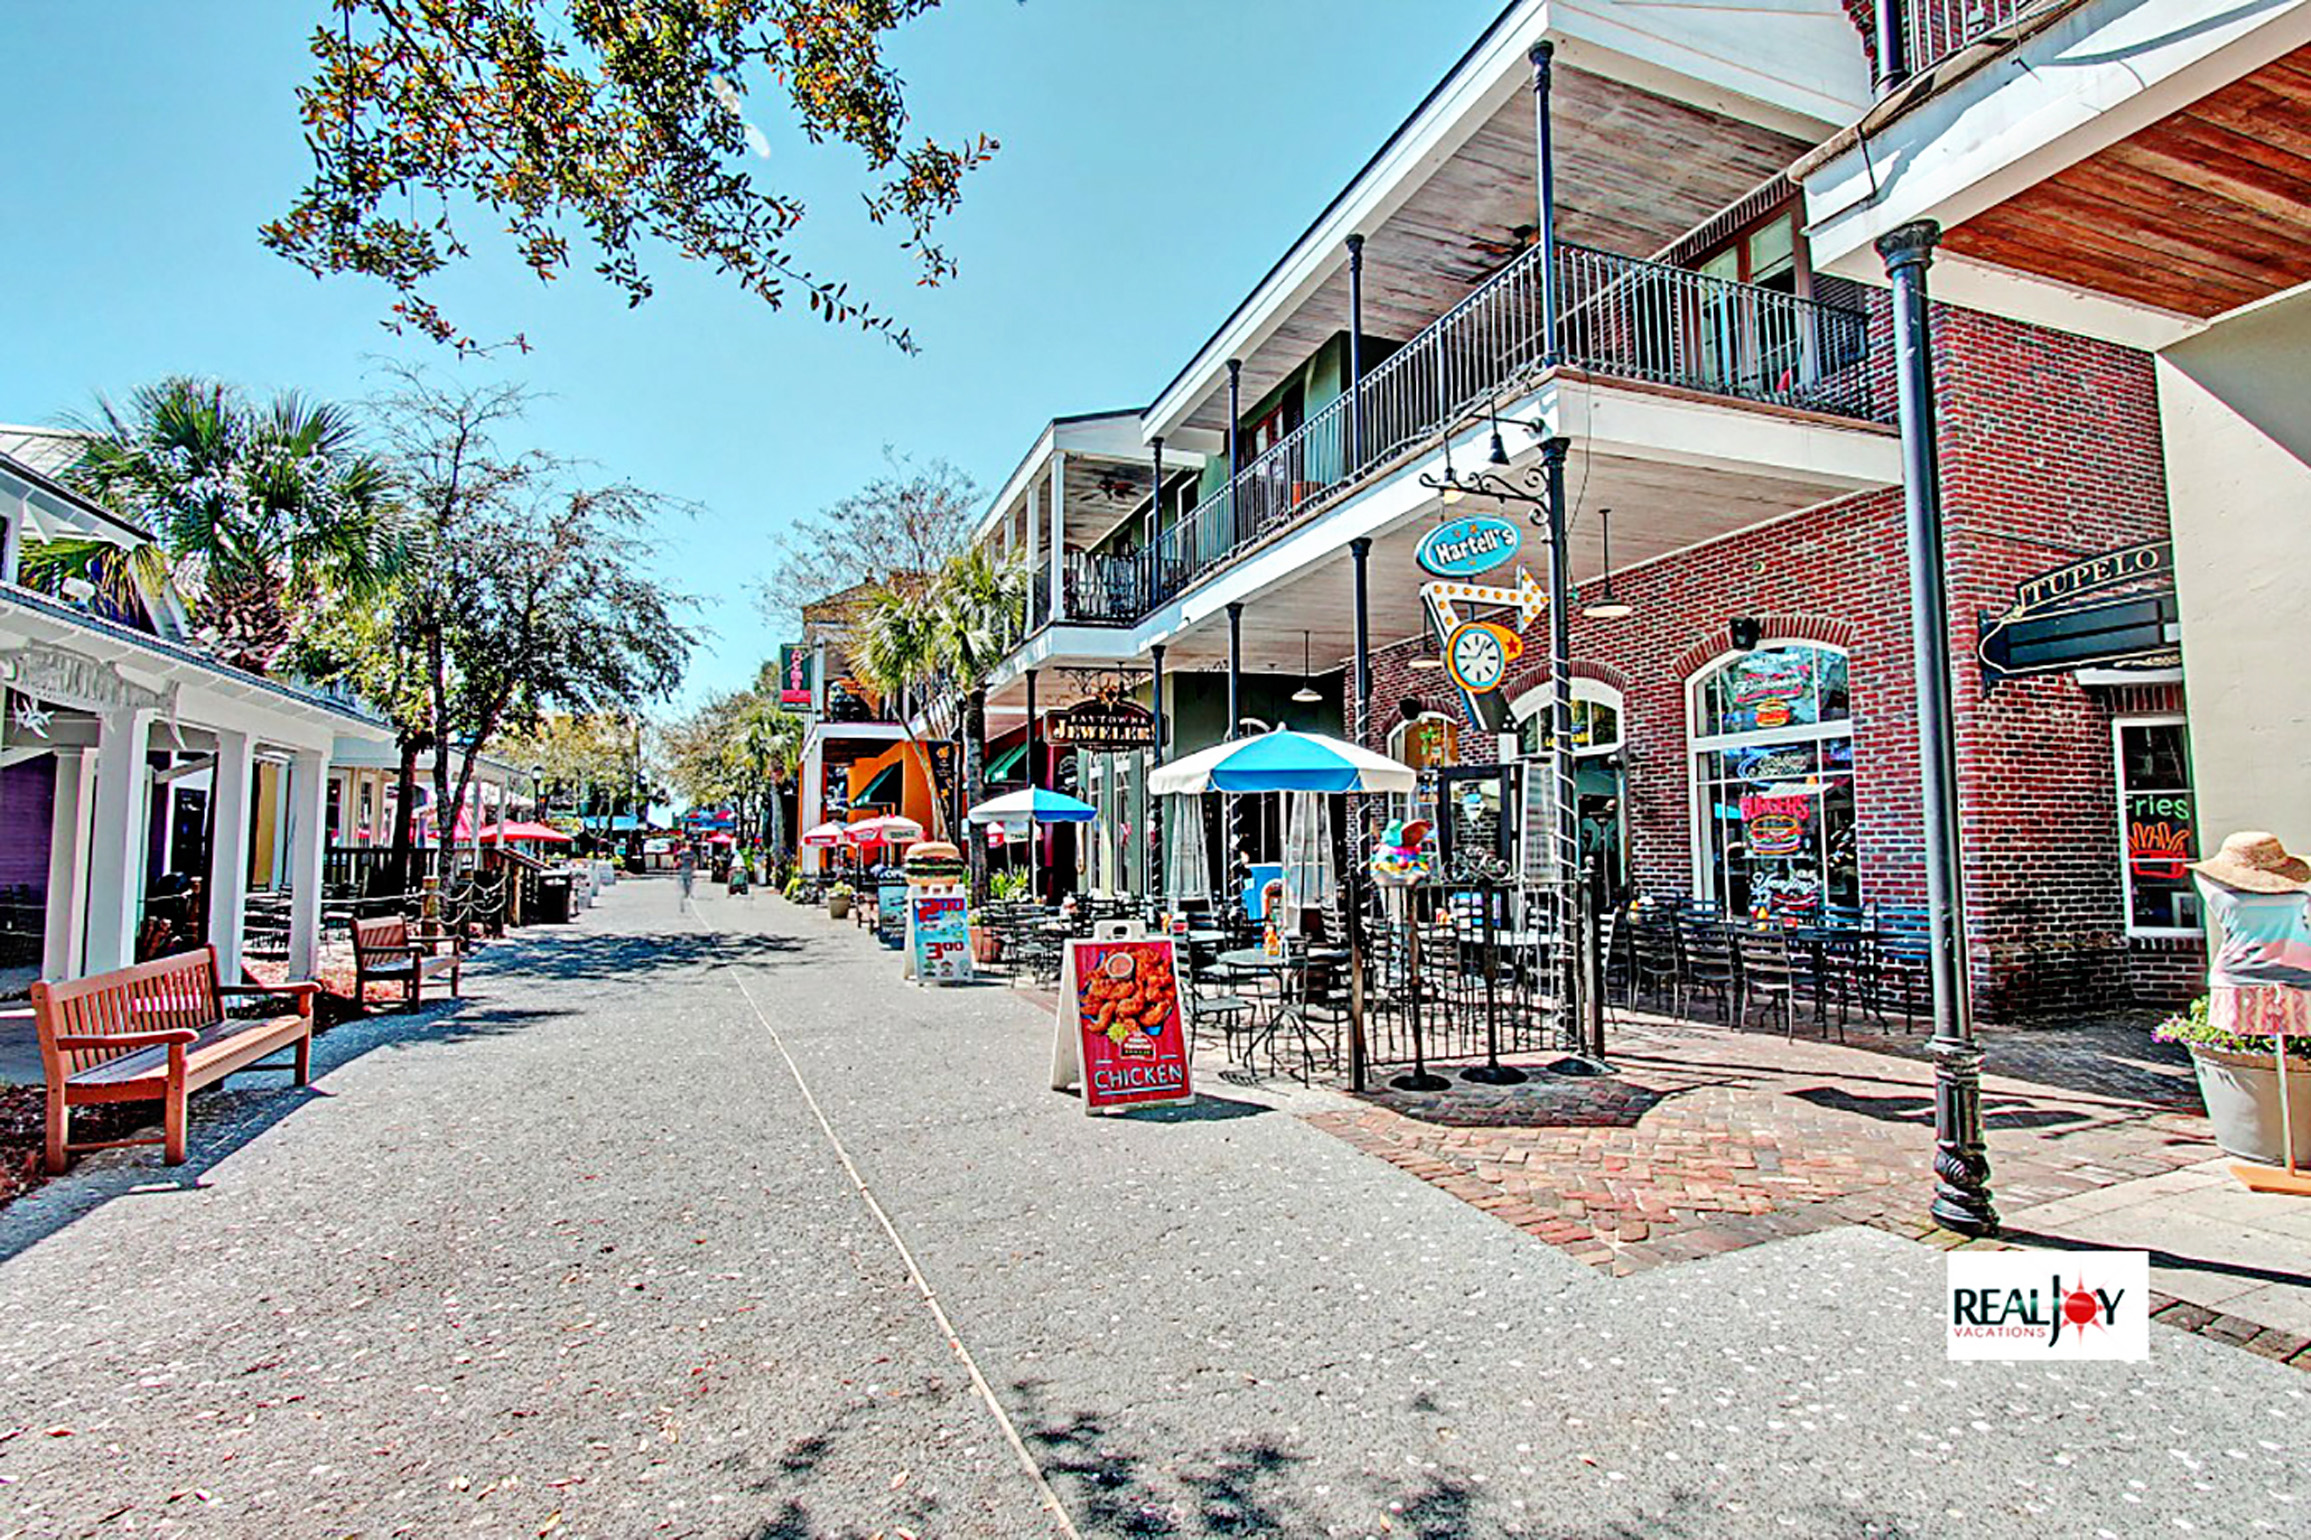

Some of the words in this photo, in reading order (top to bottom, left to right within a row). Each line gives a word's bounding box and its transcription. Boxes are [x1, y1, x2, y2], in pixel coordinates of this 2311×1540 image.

[1434, 528, 1514, 565] Hartell's
[2027, 549, 2159, 602] TUPELO
[1739, 794, 1810, 822] BURGERS
[1094, 1064, 1183, 1089] CHICKEN
